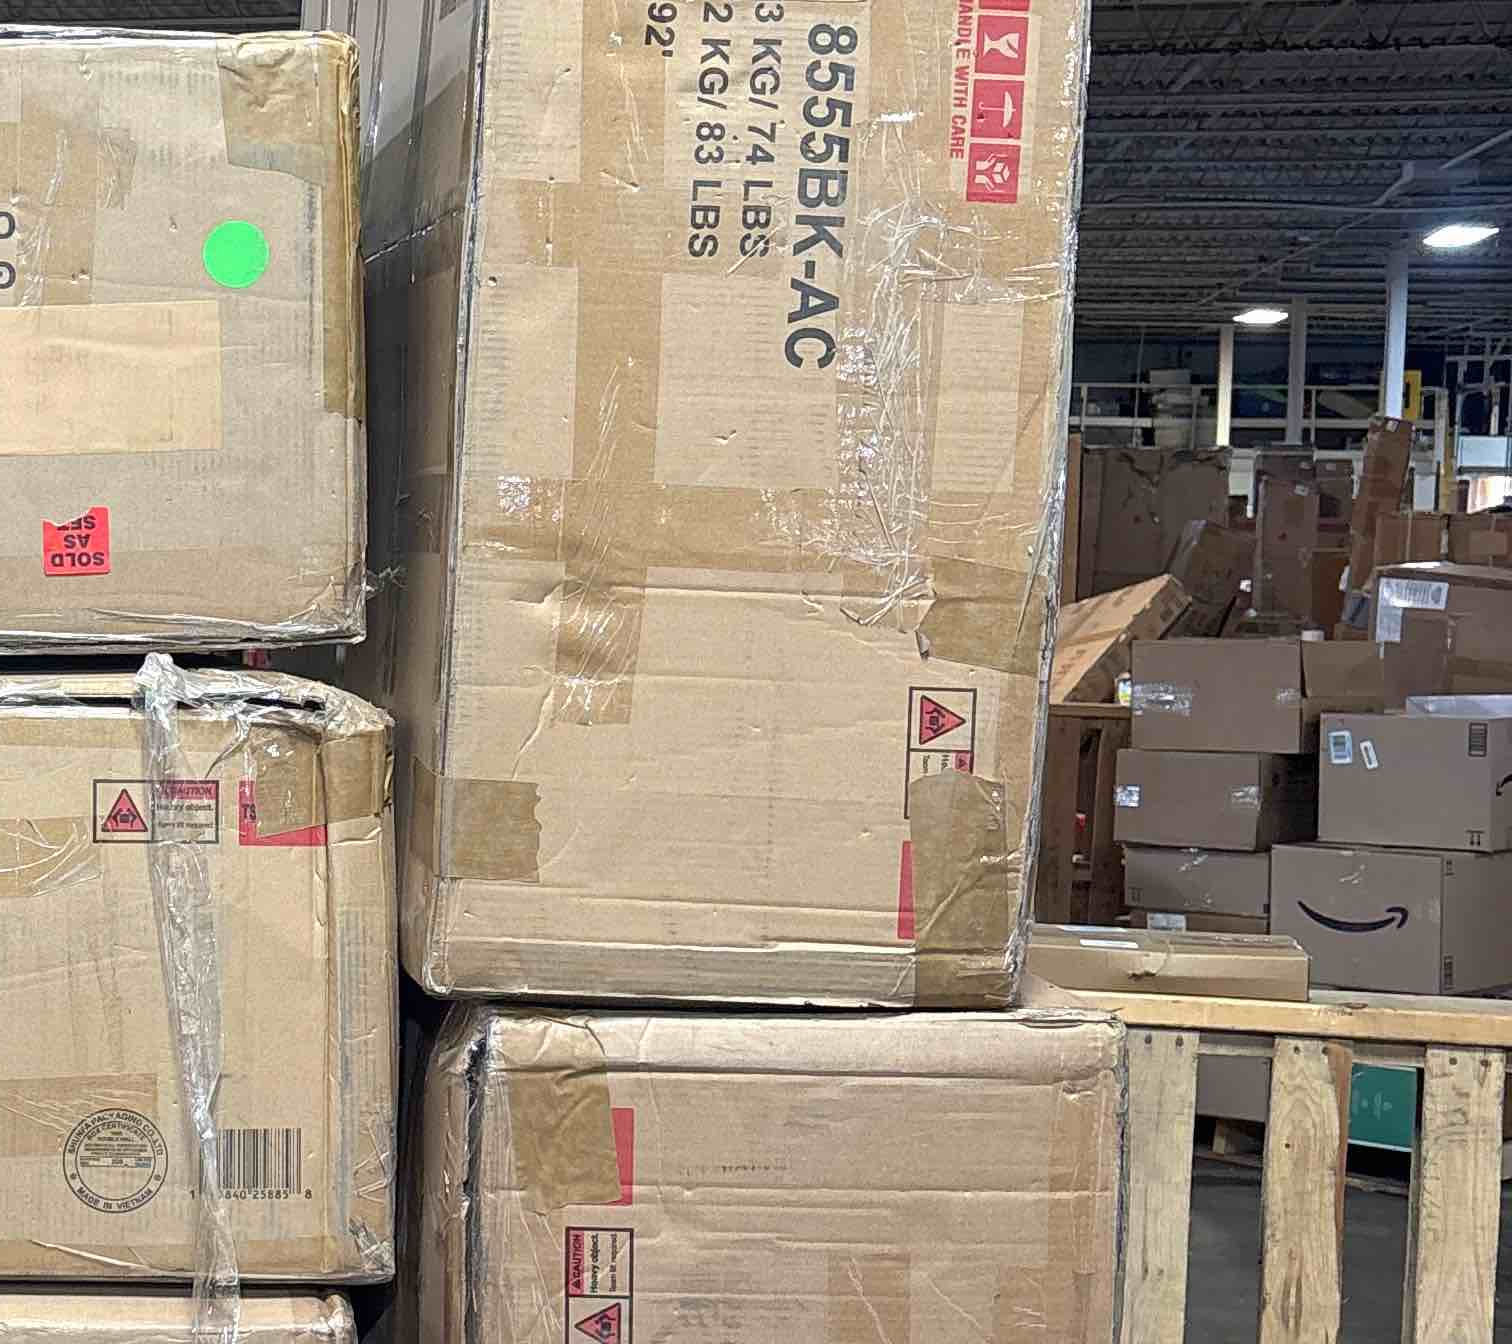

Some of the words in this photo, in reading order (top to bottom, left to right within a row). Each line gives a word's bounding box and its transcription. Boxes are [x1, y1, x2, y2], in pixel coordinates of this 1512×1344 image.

[697, 37, 731, 109] KG/
[749, 37, 783, 109] KG/
[952, 66, 970, 110] WITH
[693, 121, 726, 166] 83
[743, 123, 777, 165] 74
[948, 115, 967, 159] CARE
[783, 22, 858, 369] 8555BK-AC
[688, 181, 722, 258] LBS
[738, 181, 773, 259] LBS
[50, 552, 105, 567] SOLD
[63, 534, 91, 549] AS
[572, 1233, 582, 1279] CAUTION
